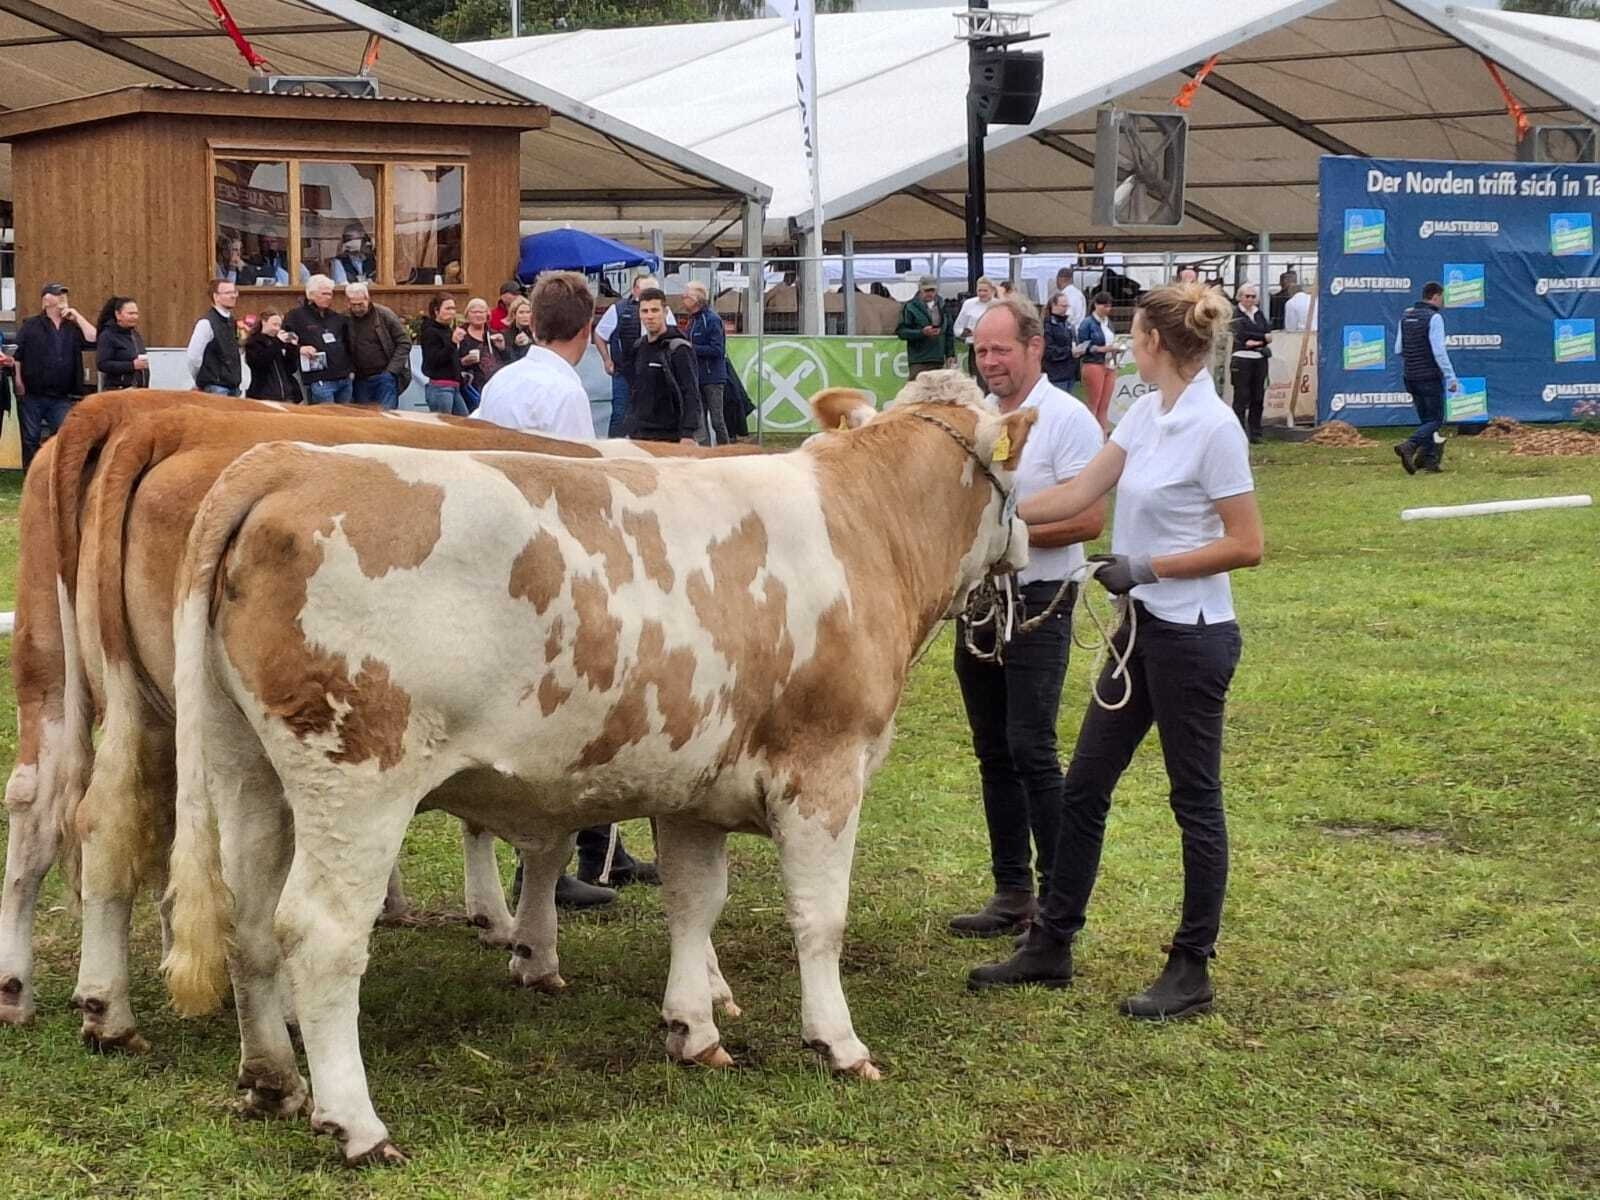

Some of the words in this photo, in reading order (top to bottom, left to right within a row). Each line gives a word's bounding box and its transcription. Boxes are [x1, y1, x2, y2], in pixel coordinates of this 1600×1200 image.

[1367, 171, 1401, 192] Der
[1406, 171, 1474, 194] Norden
[1479, 173, 1517, 195] trifft
[1520, 174, 1556, 196] sich
[1562, 176, 1580, 196] in
[1445, 335, 1501, 345] ASTERRIND
